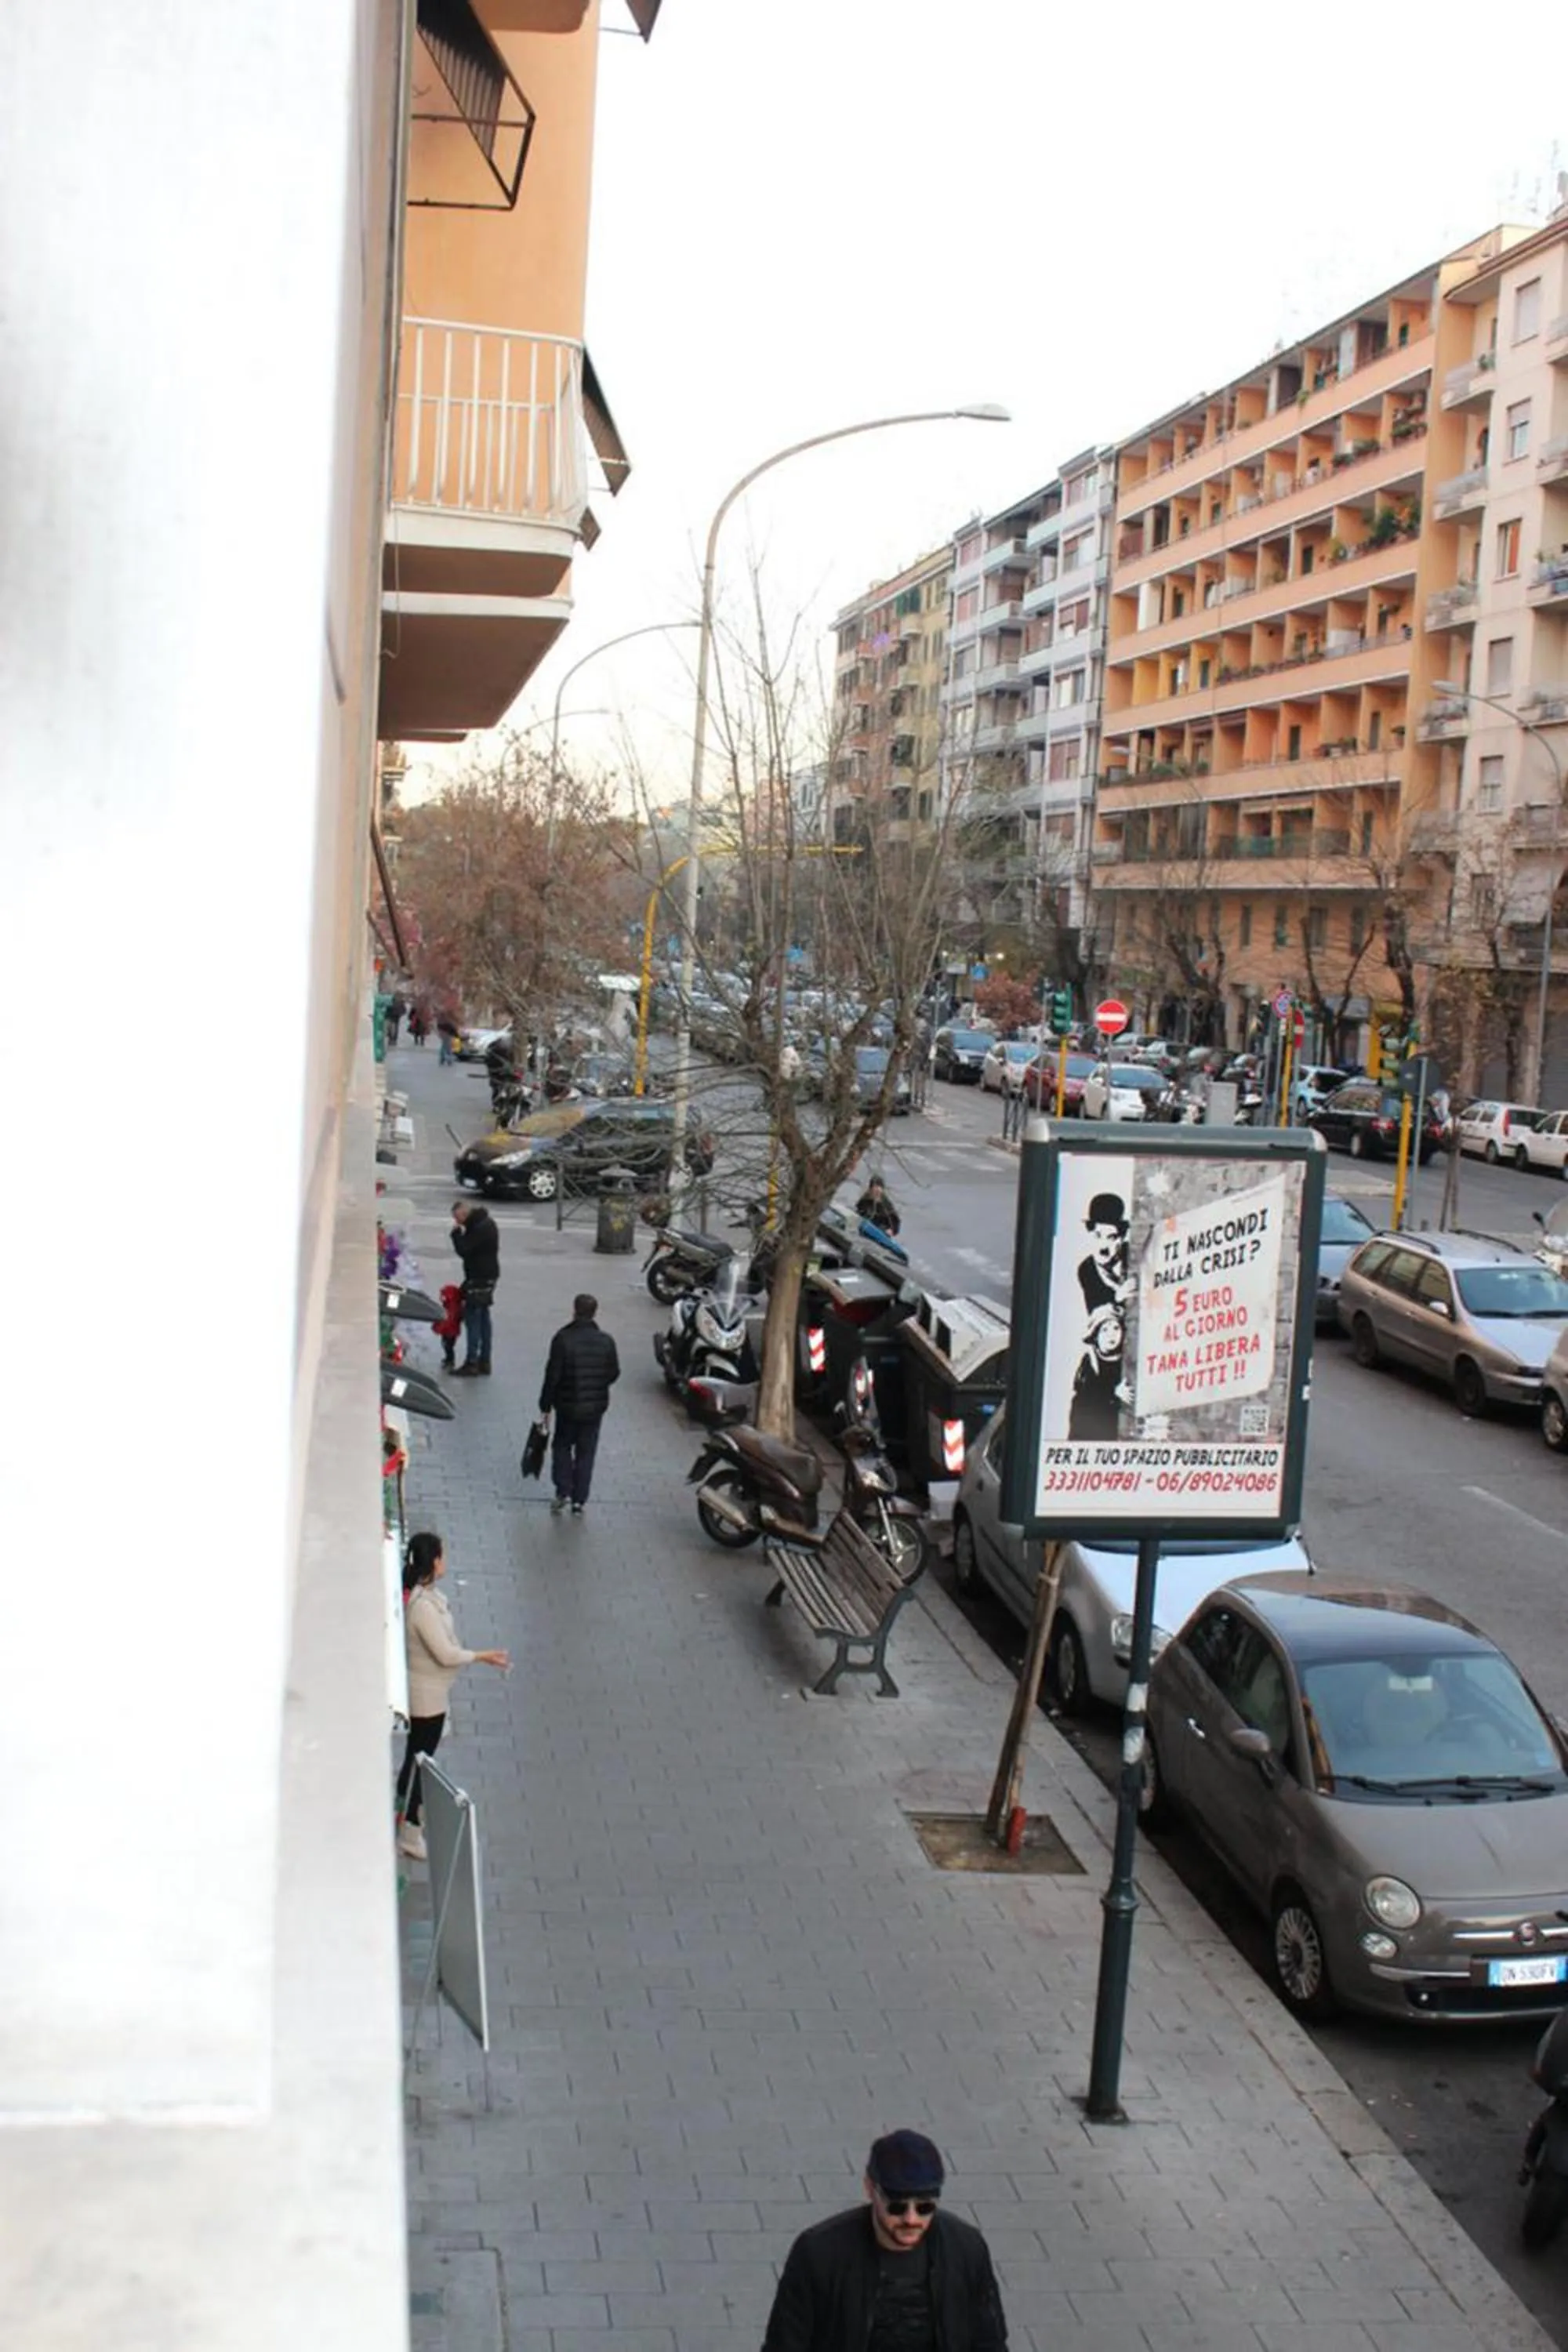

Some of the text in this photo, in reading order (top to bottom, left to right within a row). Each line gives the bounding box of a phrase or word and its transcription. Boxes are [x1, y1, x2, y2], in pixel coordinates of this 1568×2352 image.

[1163, 1207, 1269, 1261] TI NASCONDI
[1153, 1262, 1192, 1288] DALLA
[1174, 1286, 1232, 1318] 5 EURO
[1163, 1305, 1247, 1341] AL GIORNO
[1146, 1333, 1261, 1375] TANA LIBERA
[1176, 1364, 1227, 1392] TUTTI
[1045, 1447, 1279, 1467] PER IL TUO SPAZIO PUBBLICITARIO
